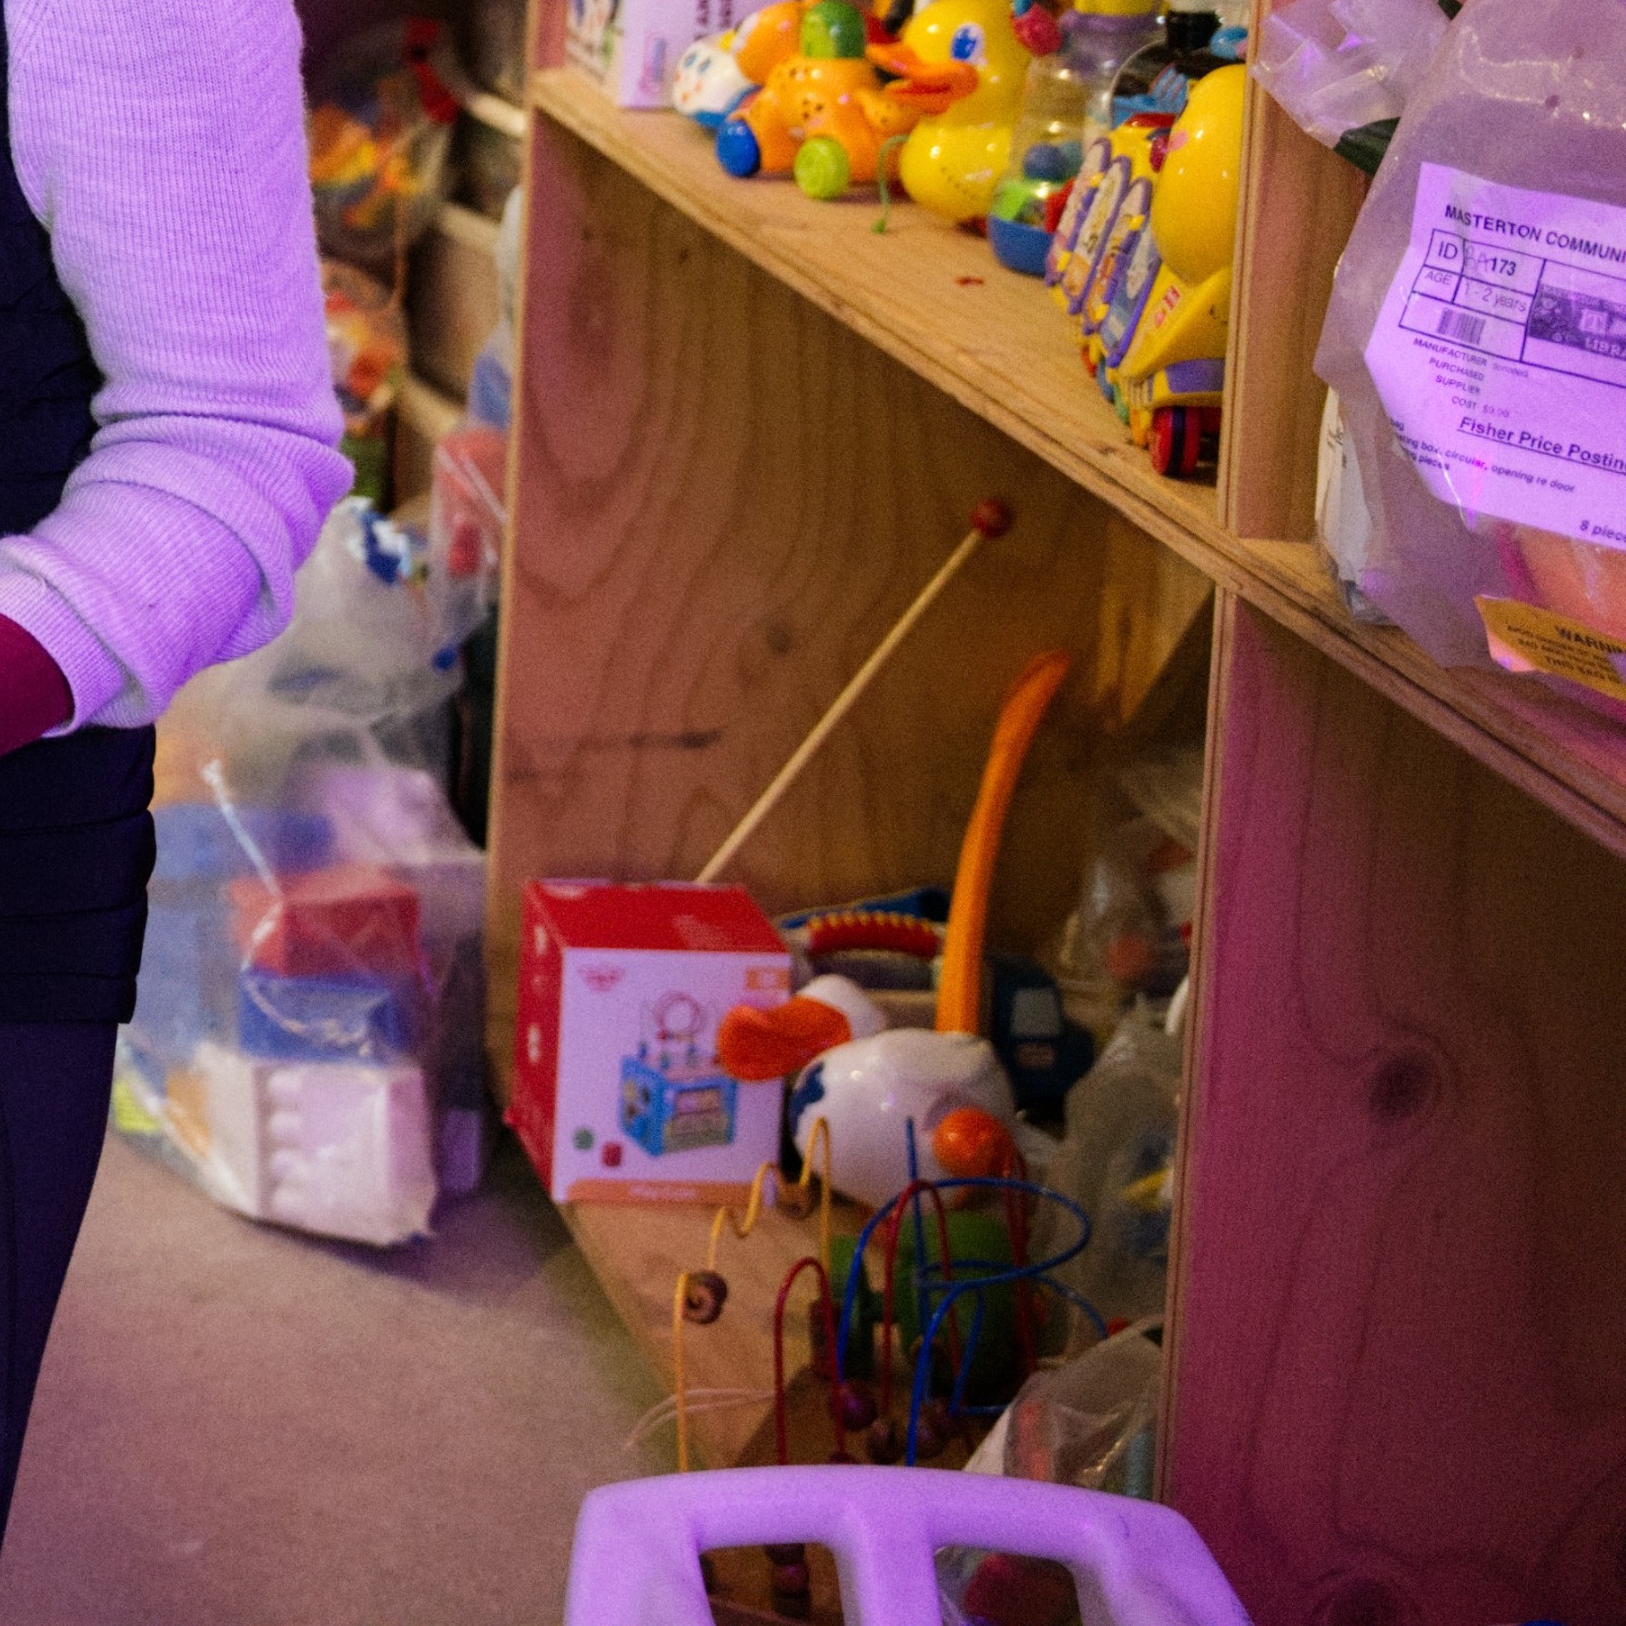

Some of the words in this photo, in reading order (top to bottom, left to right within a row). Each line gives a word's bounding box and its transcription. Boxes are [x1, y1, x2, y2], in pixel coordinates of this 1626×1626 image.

[1444, 204, 1543, 242] MASTERTON
[1544, 230, 1626, 264] COMMUNI
[1437, 240, 1459, 260] ID
[1490, 257, 1518, 277] 173
[1424, 271, 1453, 286] AGE
[1481, 287, 1492, 303] 2
[1492, 292, 1526, 314] years
[1413, 337, 1488, 367] MANUFACTURER
[1429, 357, 1485, 382] PURCHASED
[1435, 374, 1481, 396] SUPPLIER
[1451, 395, 1478, 411] COST
[1459, 416, 1514, 442] Fisher
[1518, 430, 1563, 455] Price
[1444, 449, 1488, 470] circular,
[1491, 464, 1534, 484] opening
[1549, 479, 1576, 494] door
[1579, 519, 1589, 532] 8
